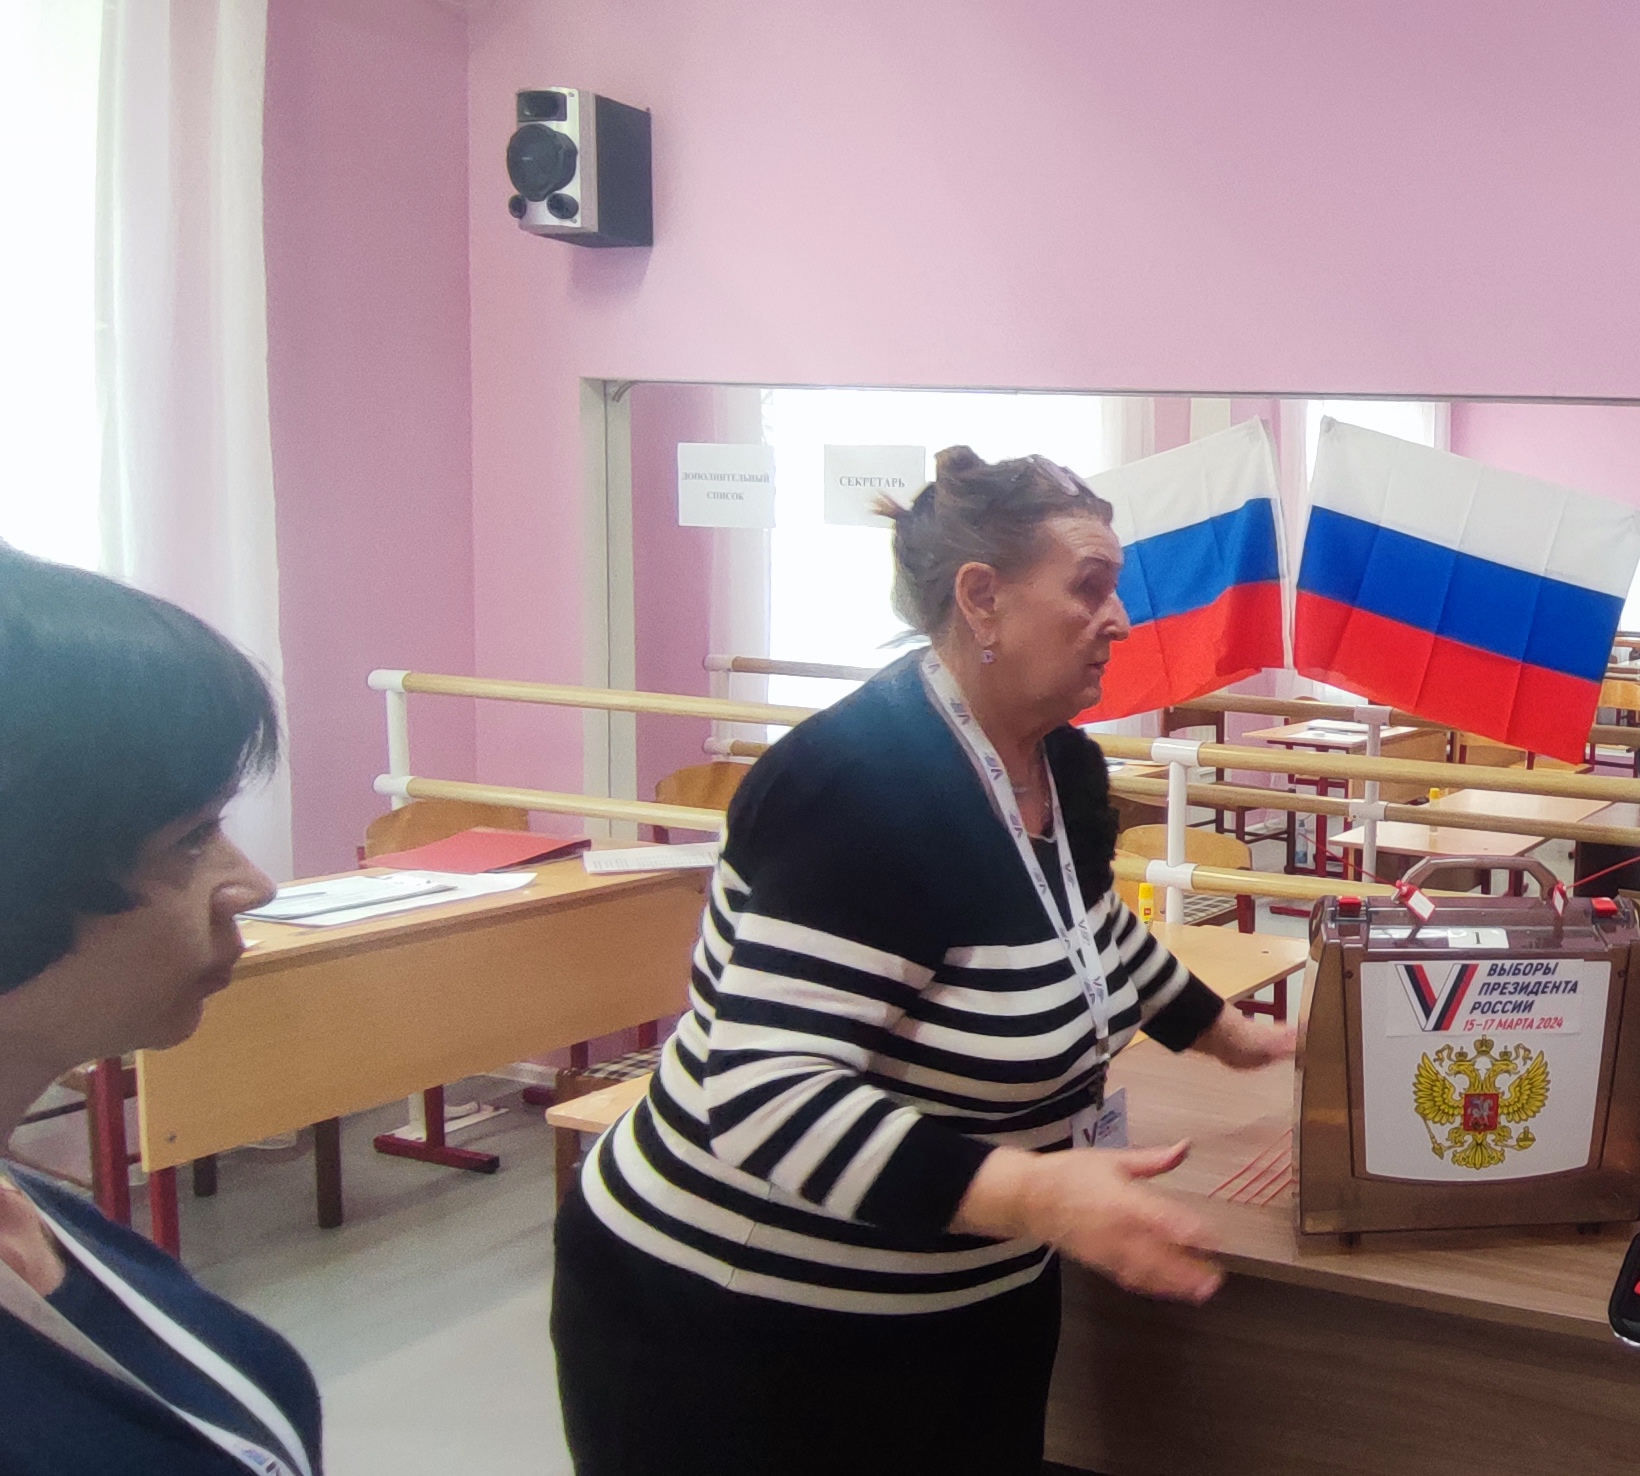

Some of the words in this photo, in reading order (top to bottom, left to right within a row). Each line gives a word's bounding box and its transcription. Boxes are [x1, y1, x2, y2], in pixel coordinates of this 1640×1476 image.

[839, 476, 906, 488] СЕКРЕТАРЬ
[706, 491, 744, 501] СПИСОК
[1486, 962, 1560, 977] ВЫБОРЫ
[1477, 980, 1579, 997] ПРЕЗИДЕНТА
[1469, 1000, 1536, 1015] РОССИИ
[1494, 1017, 1534, 1031] МАРТА
[1535, 1016, 1564, 1030] 2024
